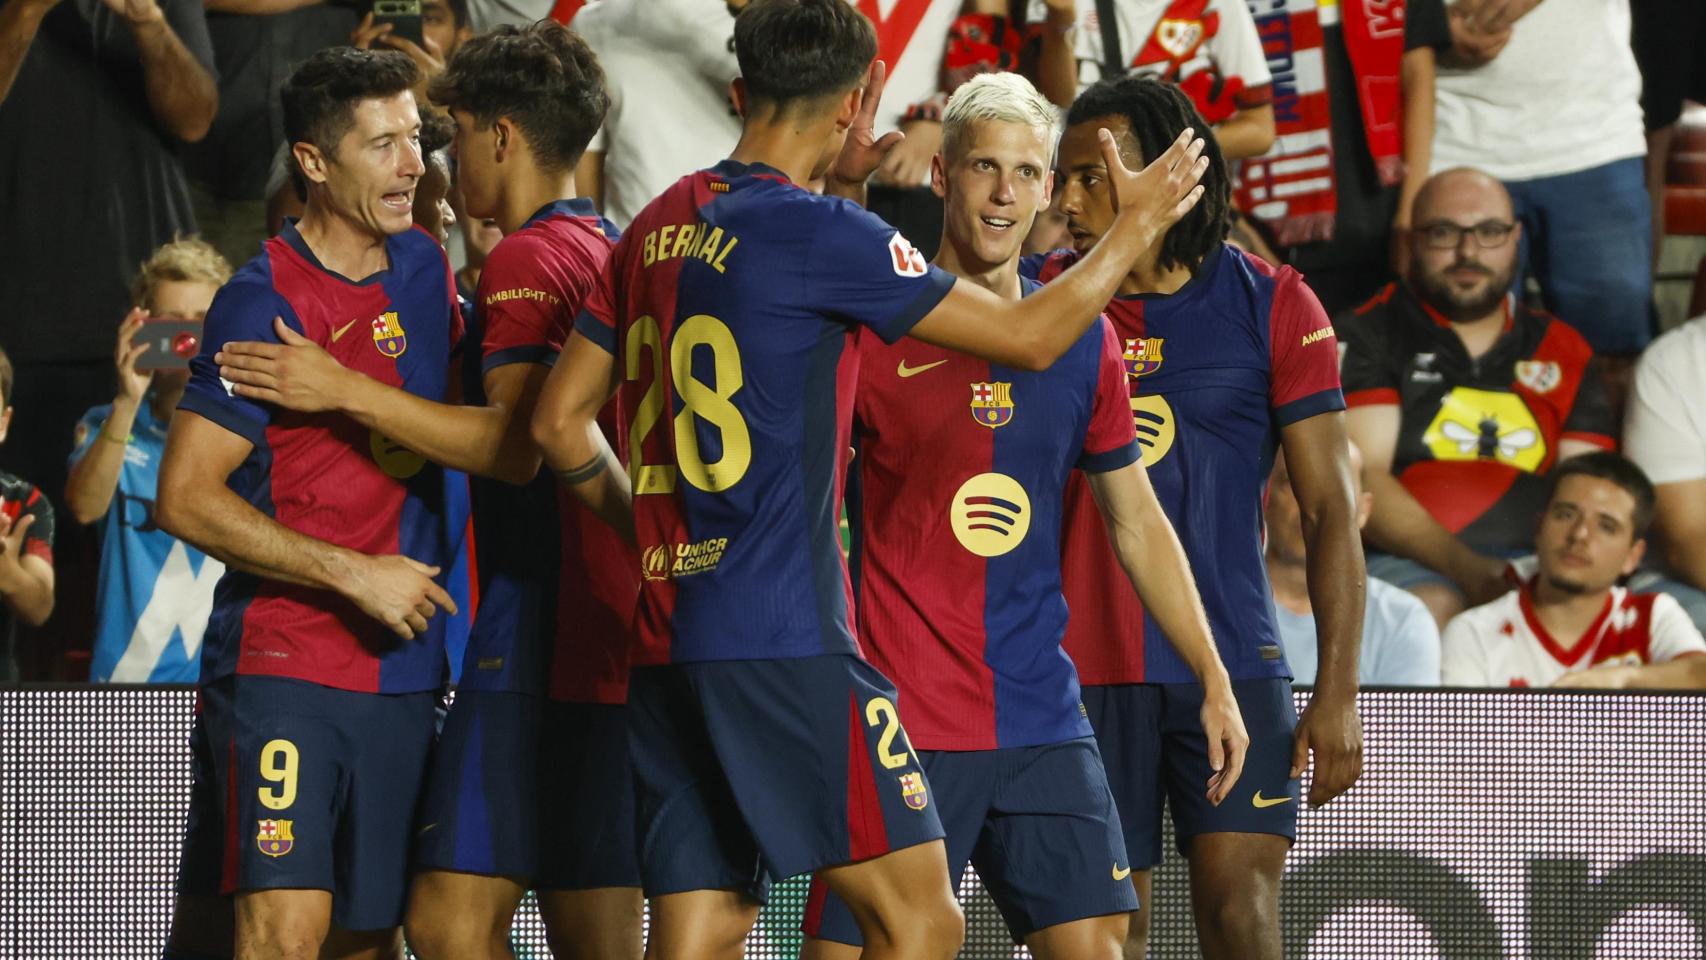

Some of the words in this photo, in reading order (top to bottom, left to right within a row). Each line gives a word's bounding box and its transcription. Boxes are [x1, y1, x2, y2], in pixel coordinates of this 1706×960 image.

[643, 222, 738, 274] BERNAL
[486, 287, 546, 305] AMBILIGHT
[625, 314, 752, 495] 28
[671, 552, 722, 571] ACNUR
[676, 538, 728, 557] UNHCR
[865, 696, 920, 770] 2
[258, 738, 300, 810] 9
